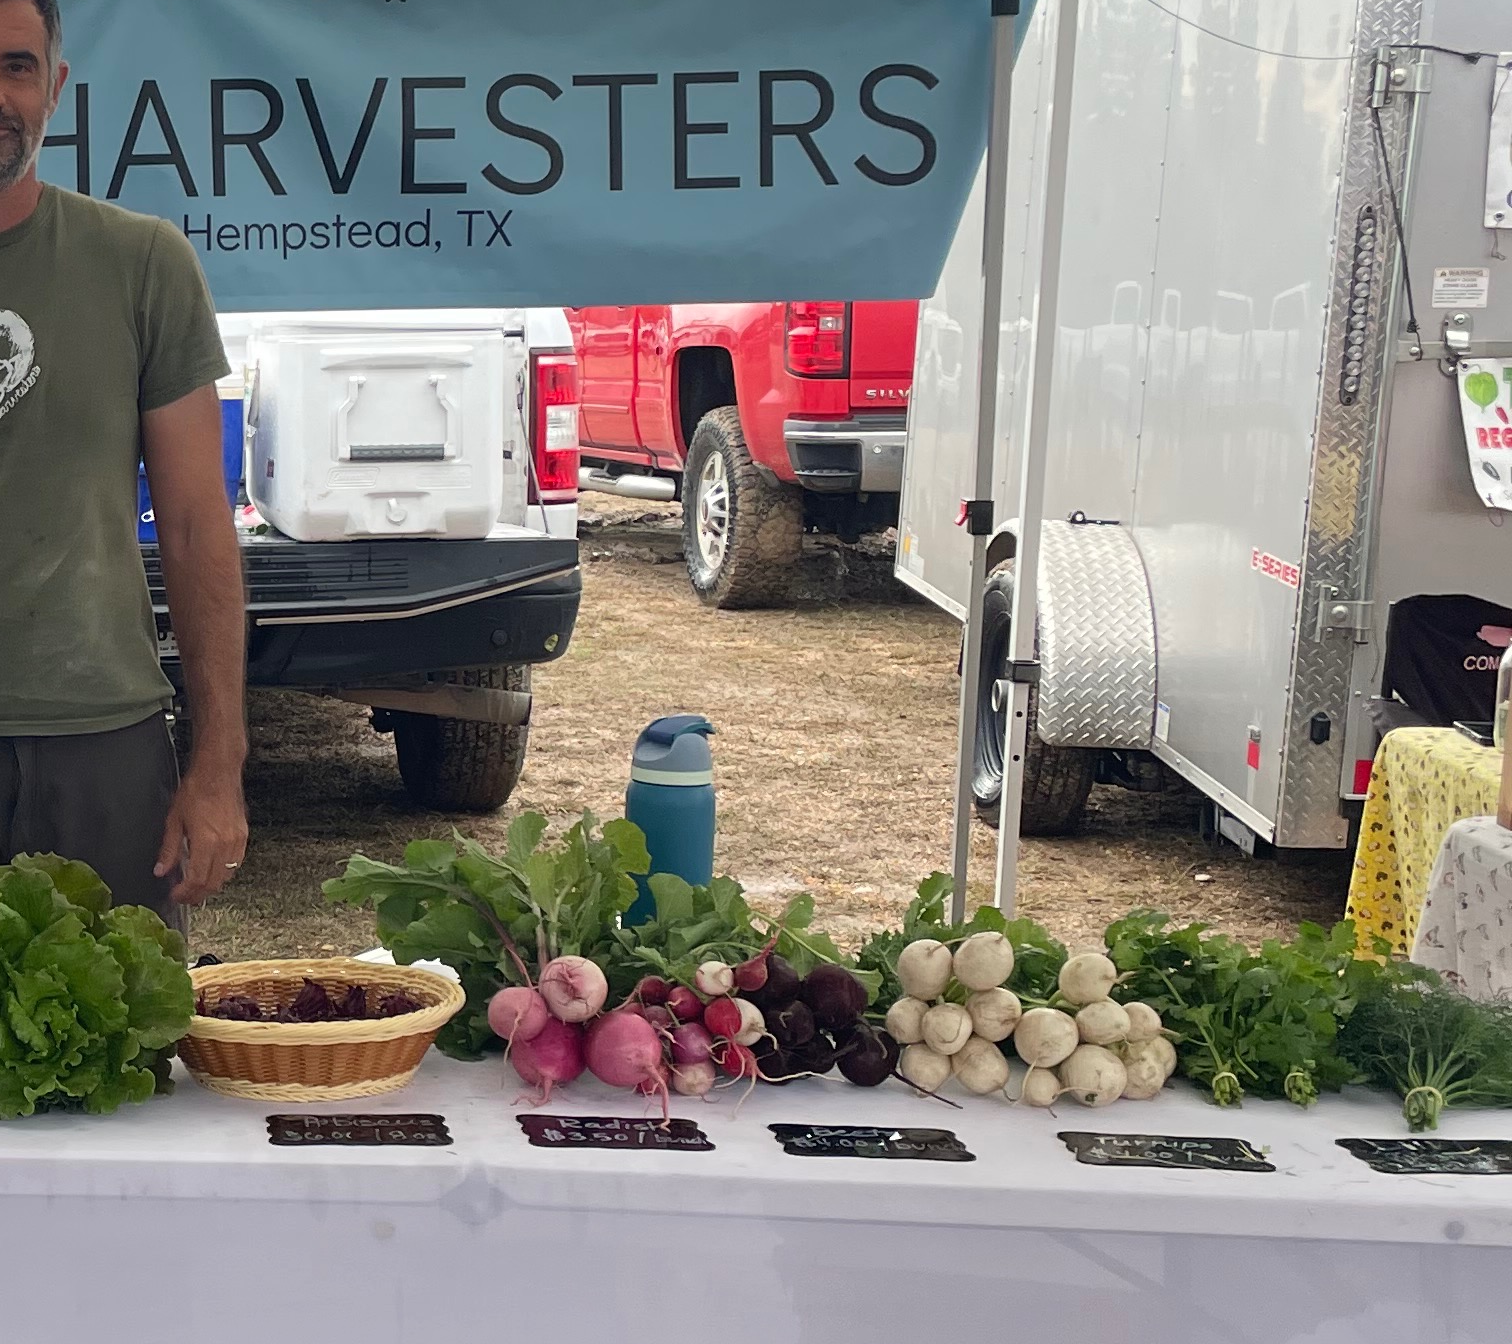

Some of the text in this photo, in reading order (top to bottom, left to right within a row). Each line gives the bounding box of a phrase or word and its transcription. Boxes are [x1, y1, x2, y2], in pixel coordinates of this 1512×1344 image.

[184, 208, 513, 260] Hempstead, TX
[1252, 550, 1299, 587] E-SERIES
[541, 1128, 629, 1142] $3.50
